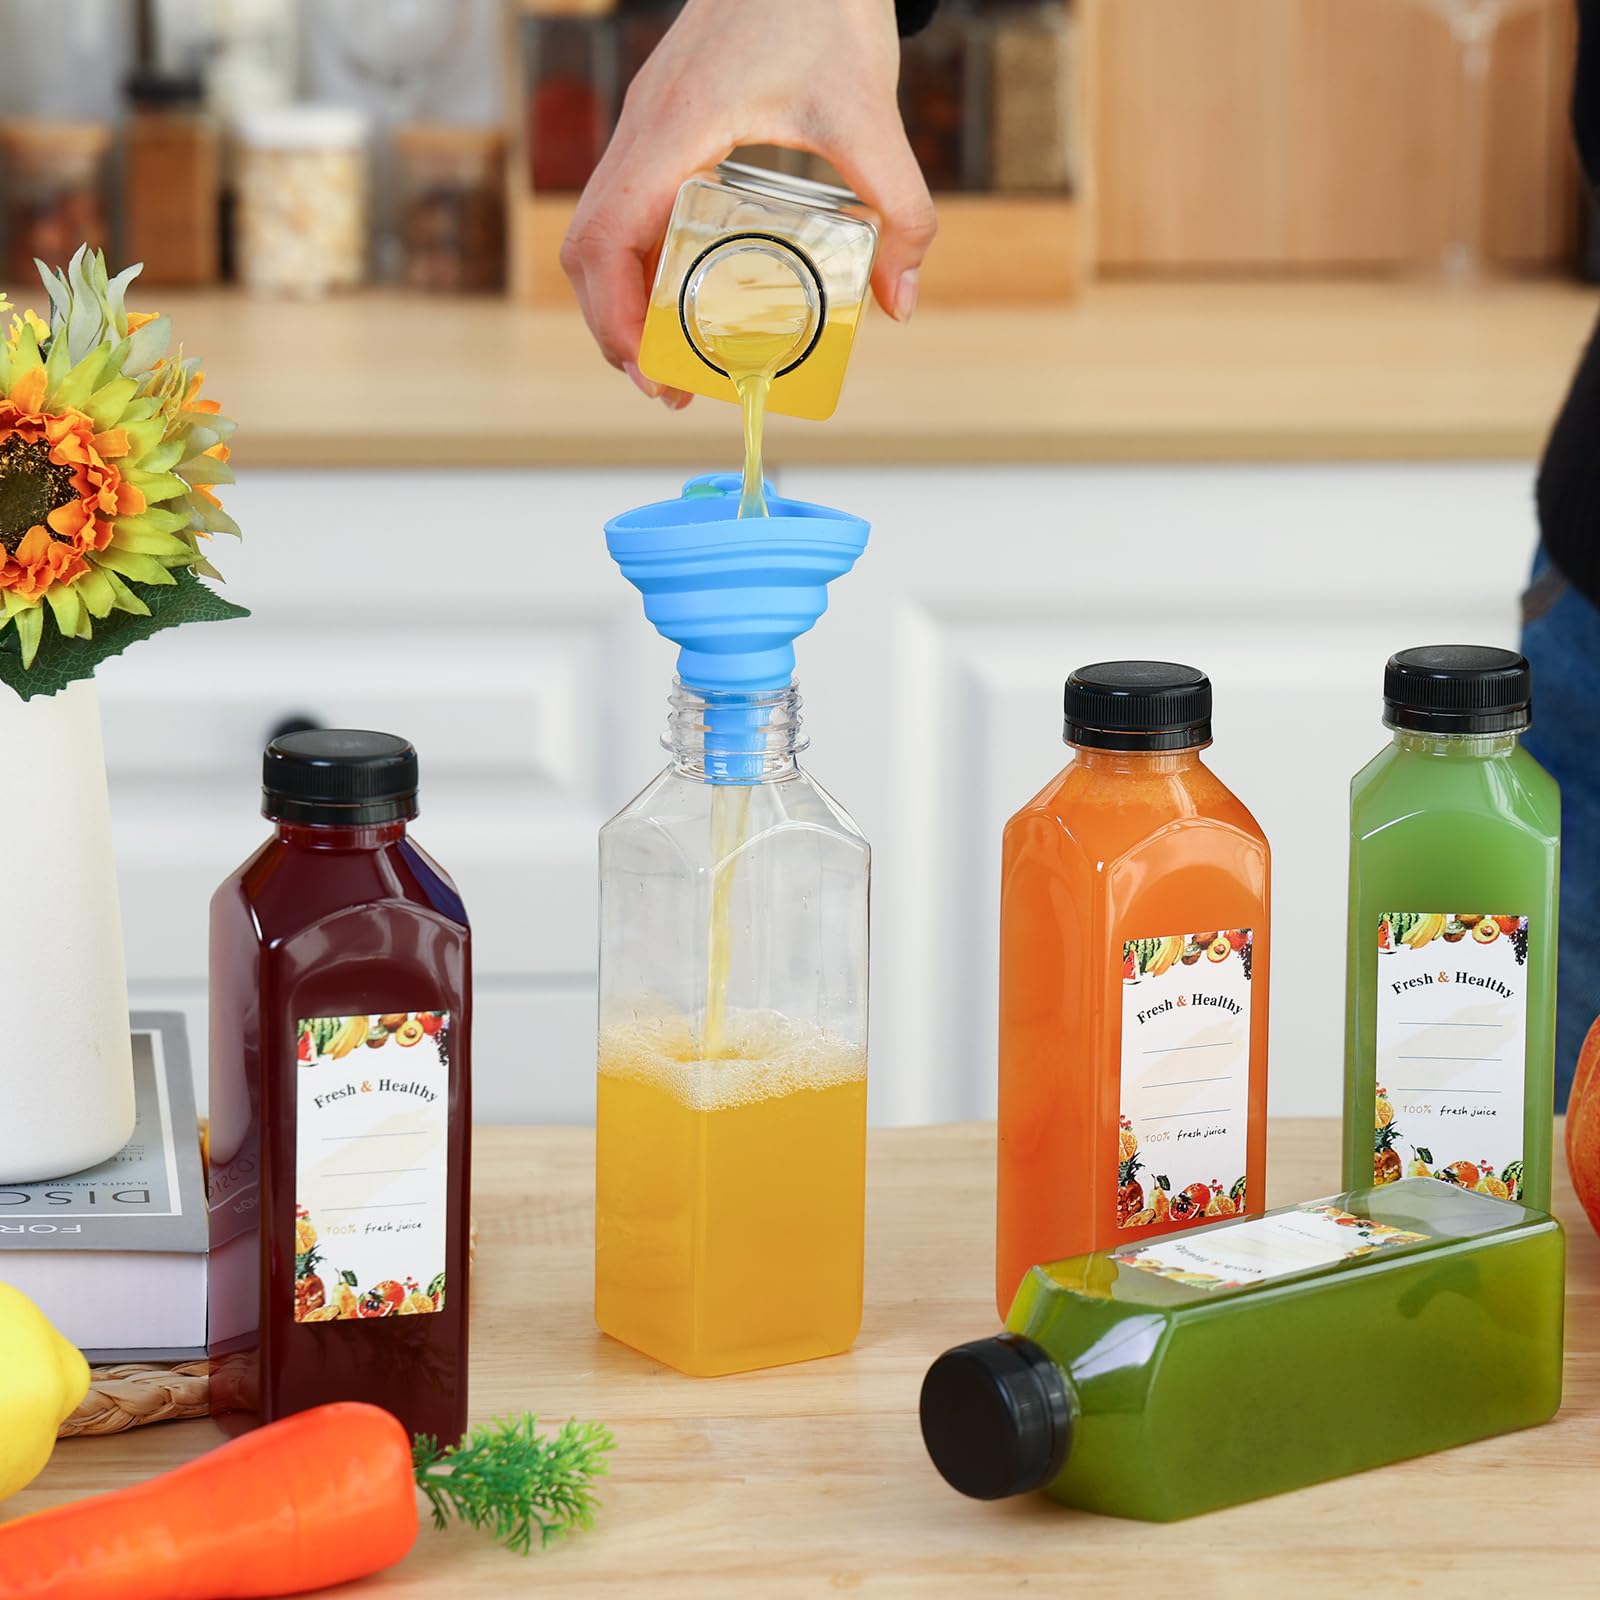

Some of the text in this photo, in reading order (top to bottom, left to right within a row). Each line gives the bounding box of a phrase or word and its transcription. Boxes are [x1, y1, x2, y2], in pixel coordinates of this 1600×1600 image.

[1391, 970, 1515, 999] Fresh & Healthy
[1136, 993, 1243, 1025] Fresh & Healthy
[313, 1078, 439, 1110] Fresh & Healthy
[1402, 1104, 1497, 1118] 100% fresh juice
[1144, 1125, 1227, 1143] 100% fresh juice
[364, 1222, 393, 1234] fresh
[396, 1219, 423, 1232] juice
